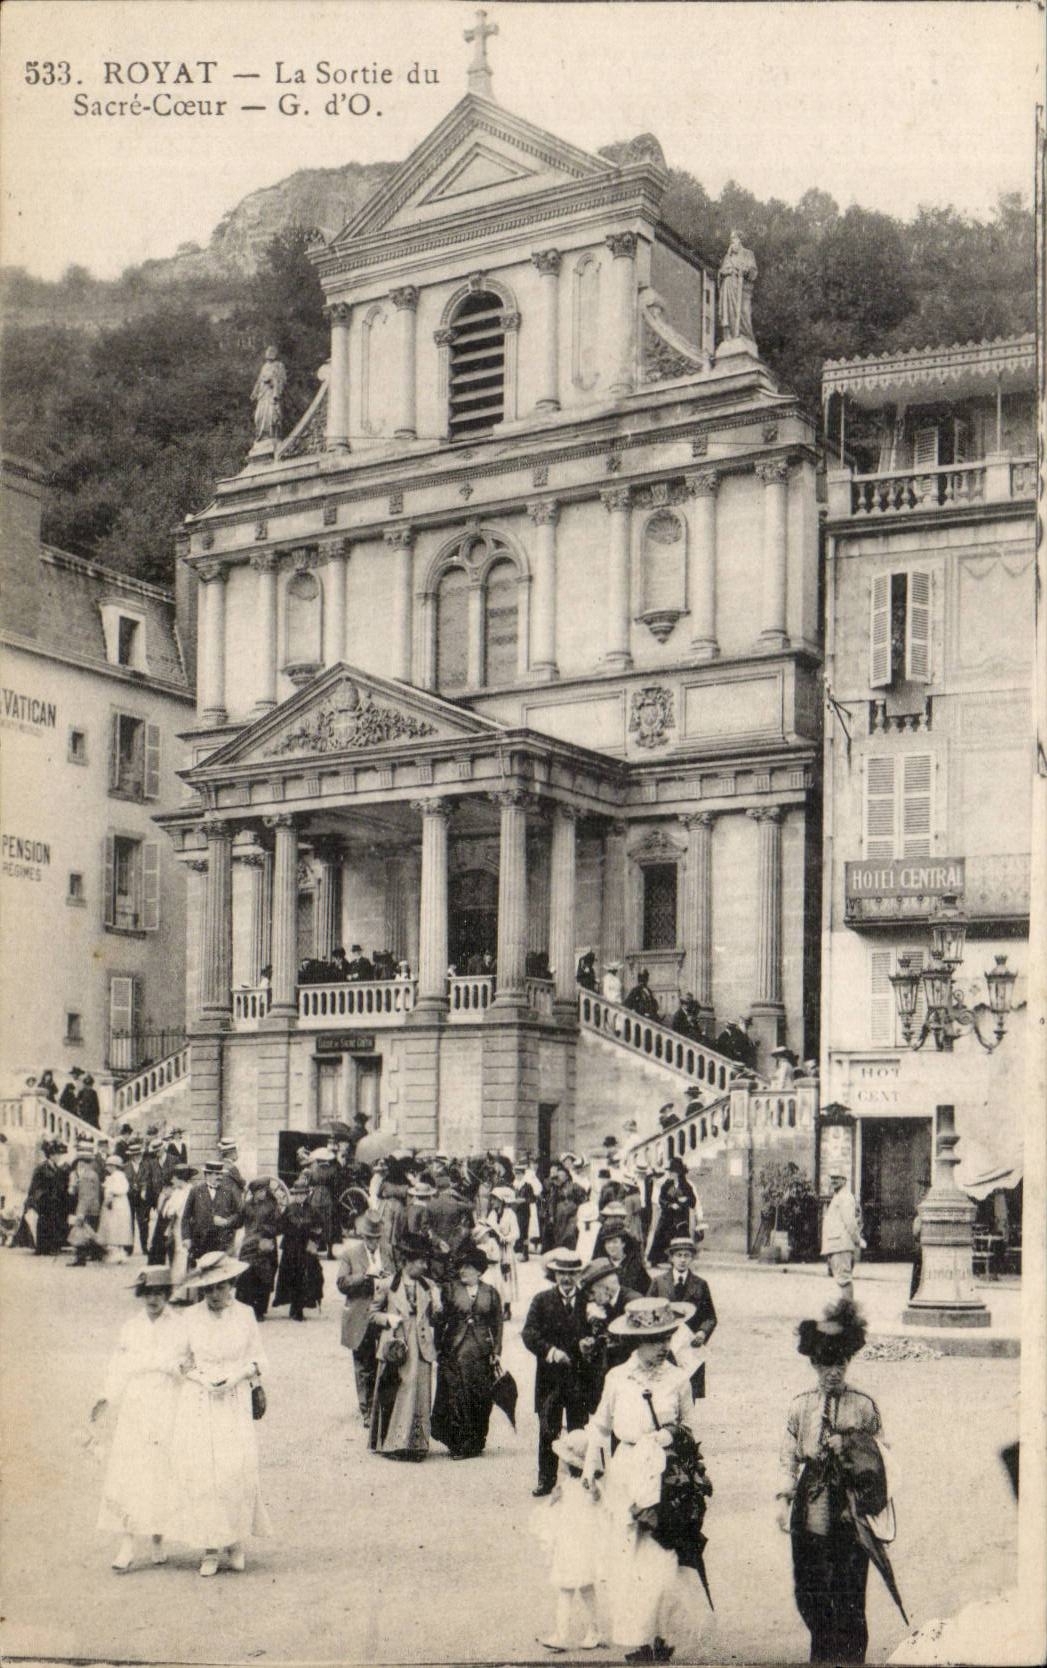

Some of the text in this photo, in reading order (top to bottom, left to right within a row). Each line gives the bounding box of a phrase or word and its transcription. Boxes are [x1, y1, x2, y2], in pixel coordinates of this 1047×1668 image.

[2, 688, 57, 728] VATICAN
[2, 834, 51, 865] PENSION
[900, 866, 964, 889] CENTRAL
